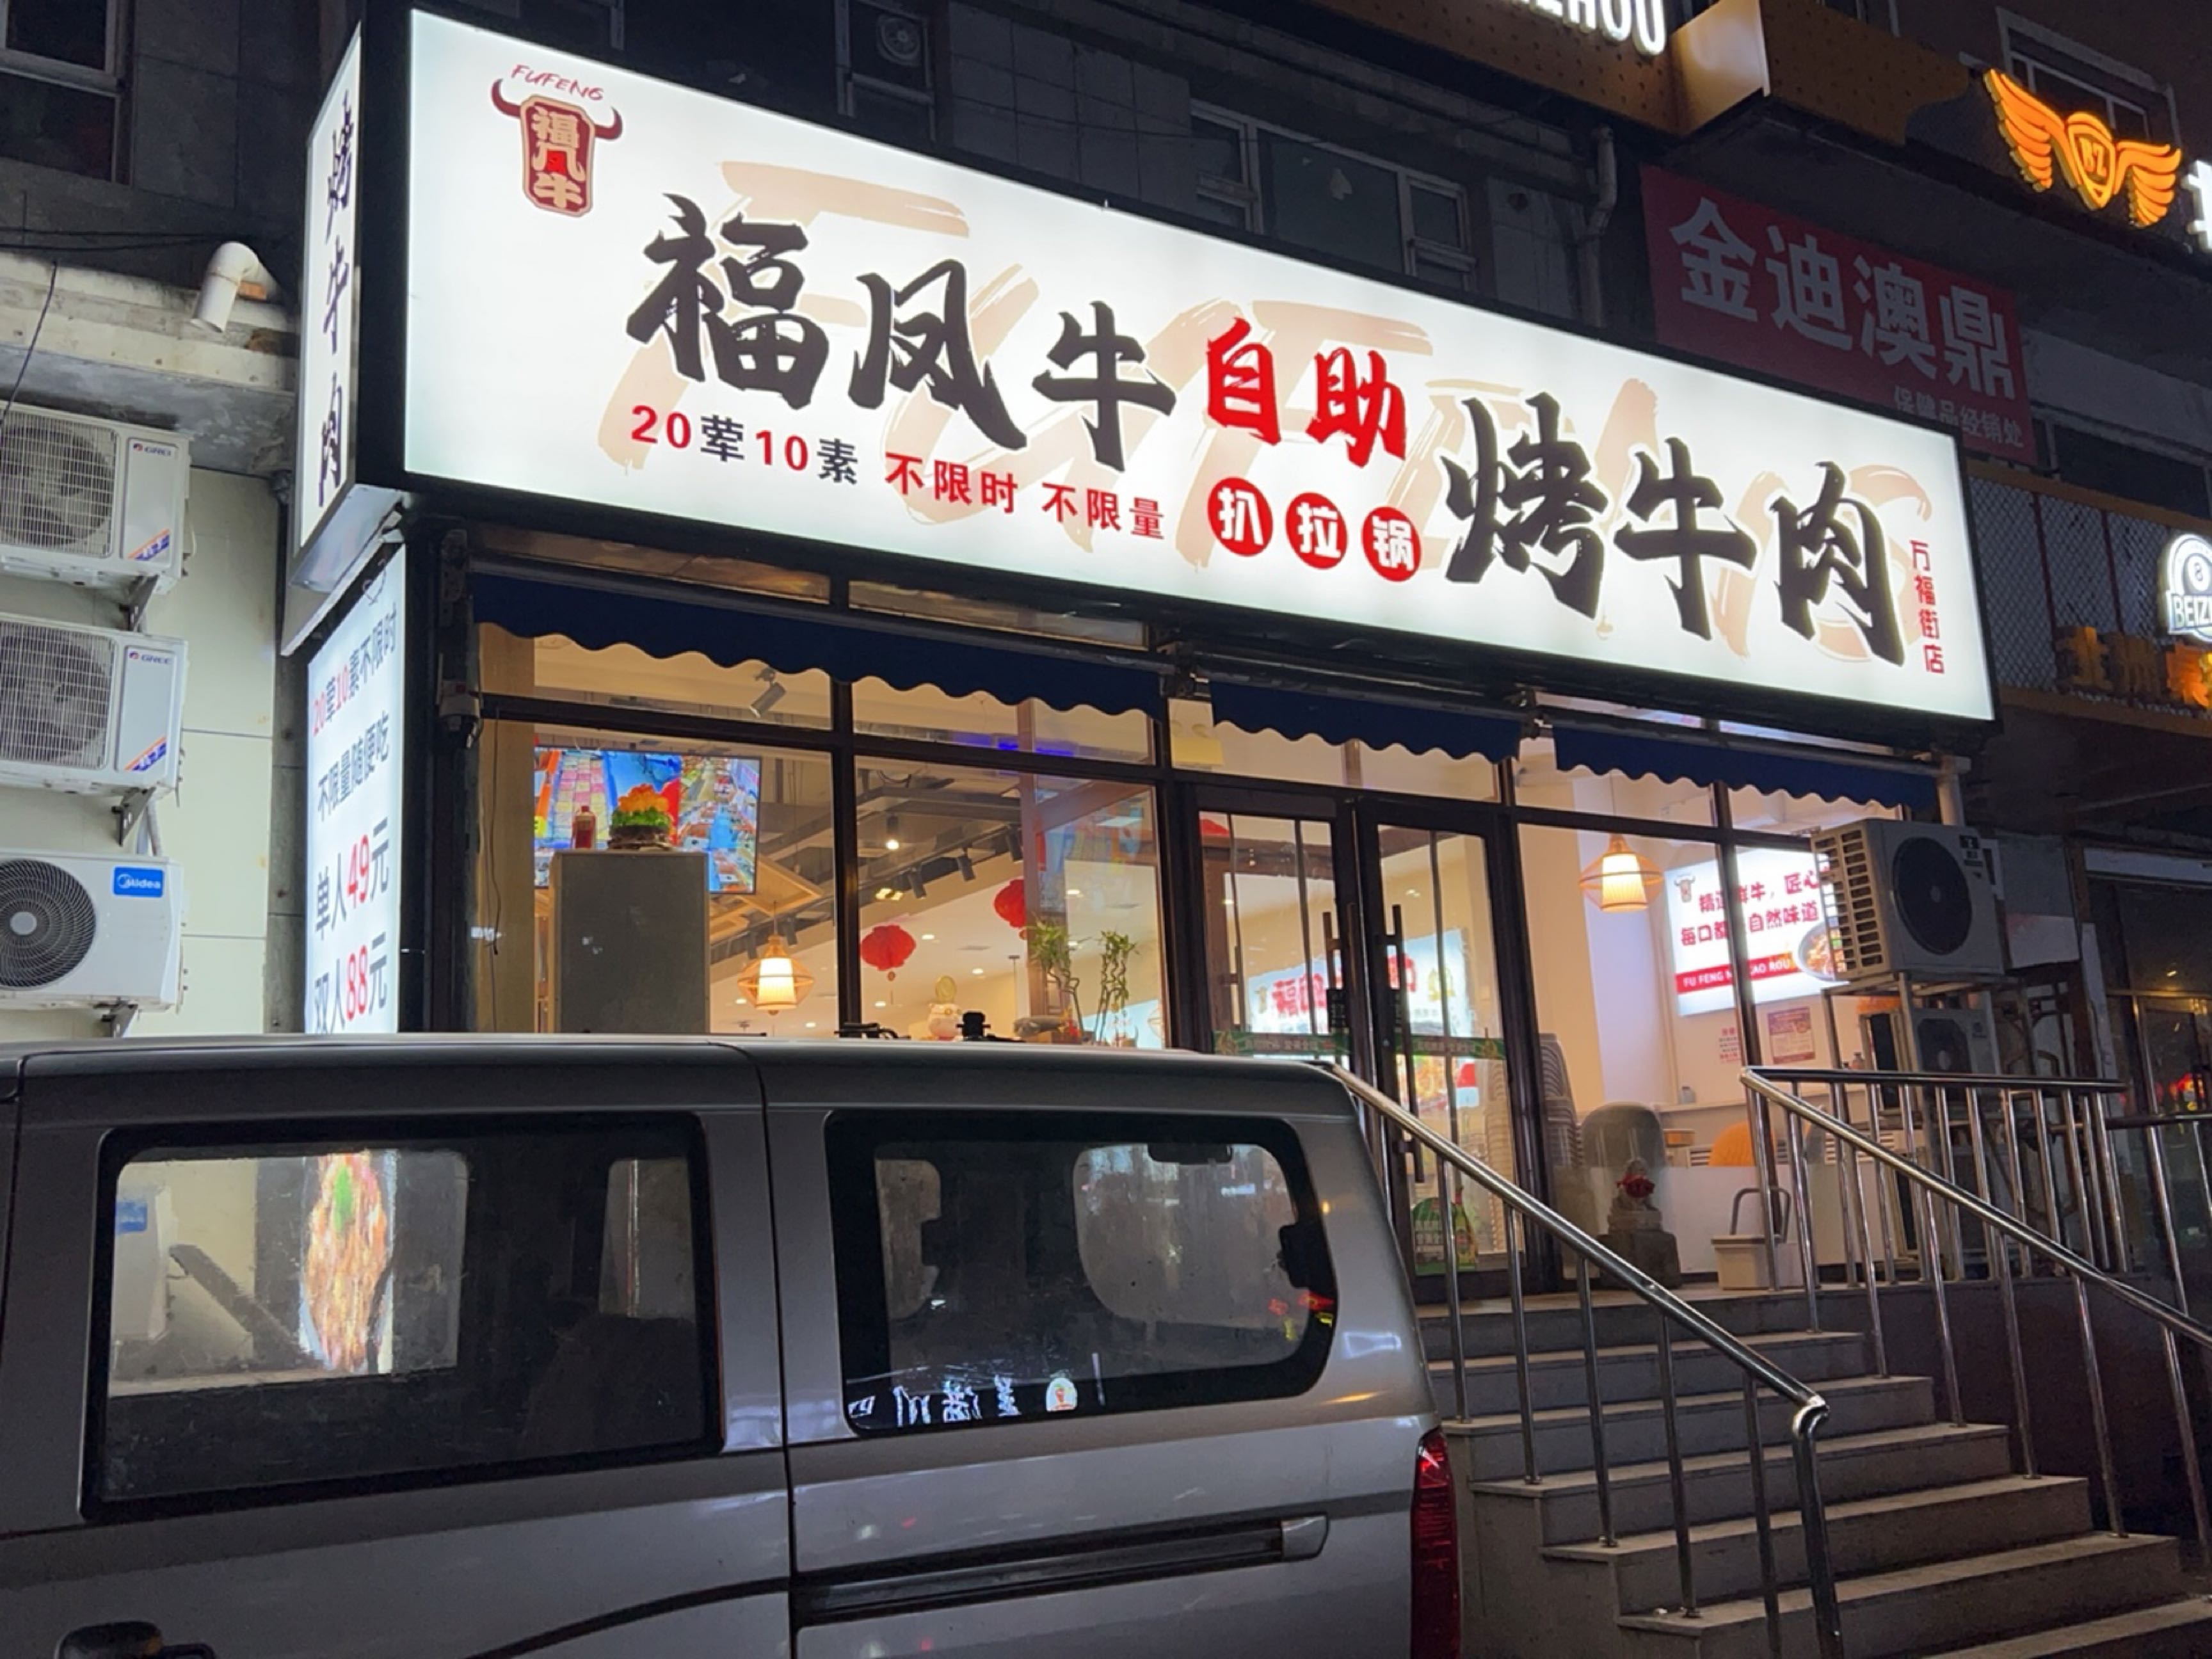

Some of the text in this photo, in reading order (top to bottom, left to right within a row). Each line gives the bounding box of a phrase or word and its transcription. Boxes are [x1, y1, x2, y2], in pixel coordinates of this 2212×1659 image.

[511, 64, 605, 100] FUFENG
[1670, 196, 2016, 401] 金迪澳鼎
[626, 193, 1904, 666] 福凤牛 自助 烤牛肉
[631, 405, 1165, 541] 20荤10素 不限时 不限量
[1216, 486, 1414, 572] 扒拉锅
[1909, 539, 1945, 674] 万福街店
[2174, 594, 2212, 630] BEIZ
[315, 817, 389, 940] 单人49元
[315, 932, 387, 1034] 双人88元
